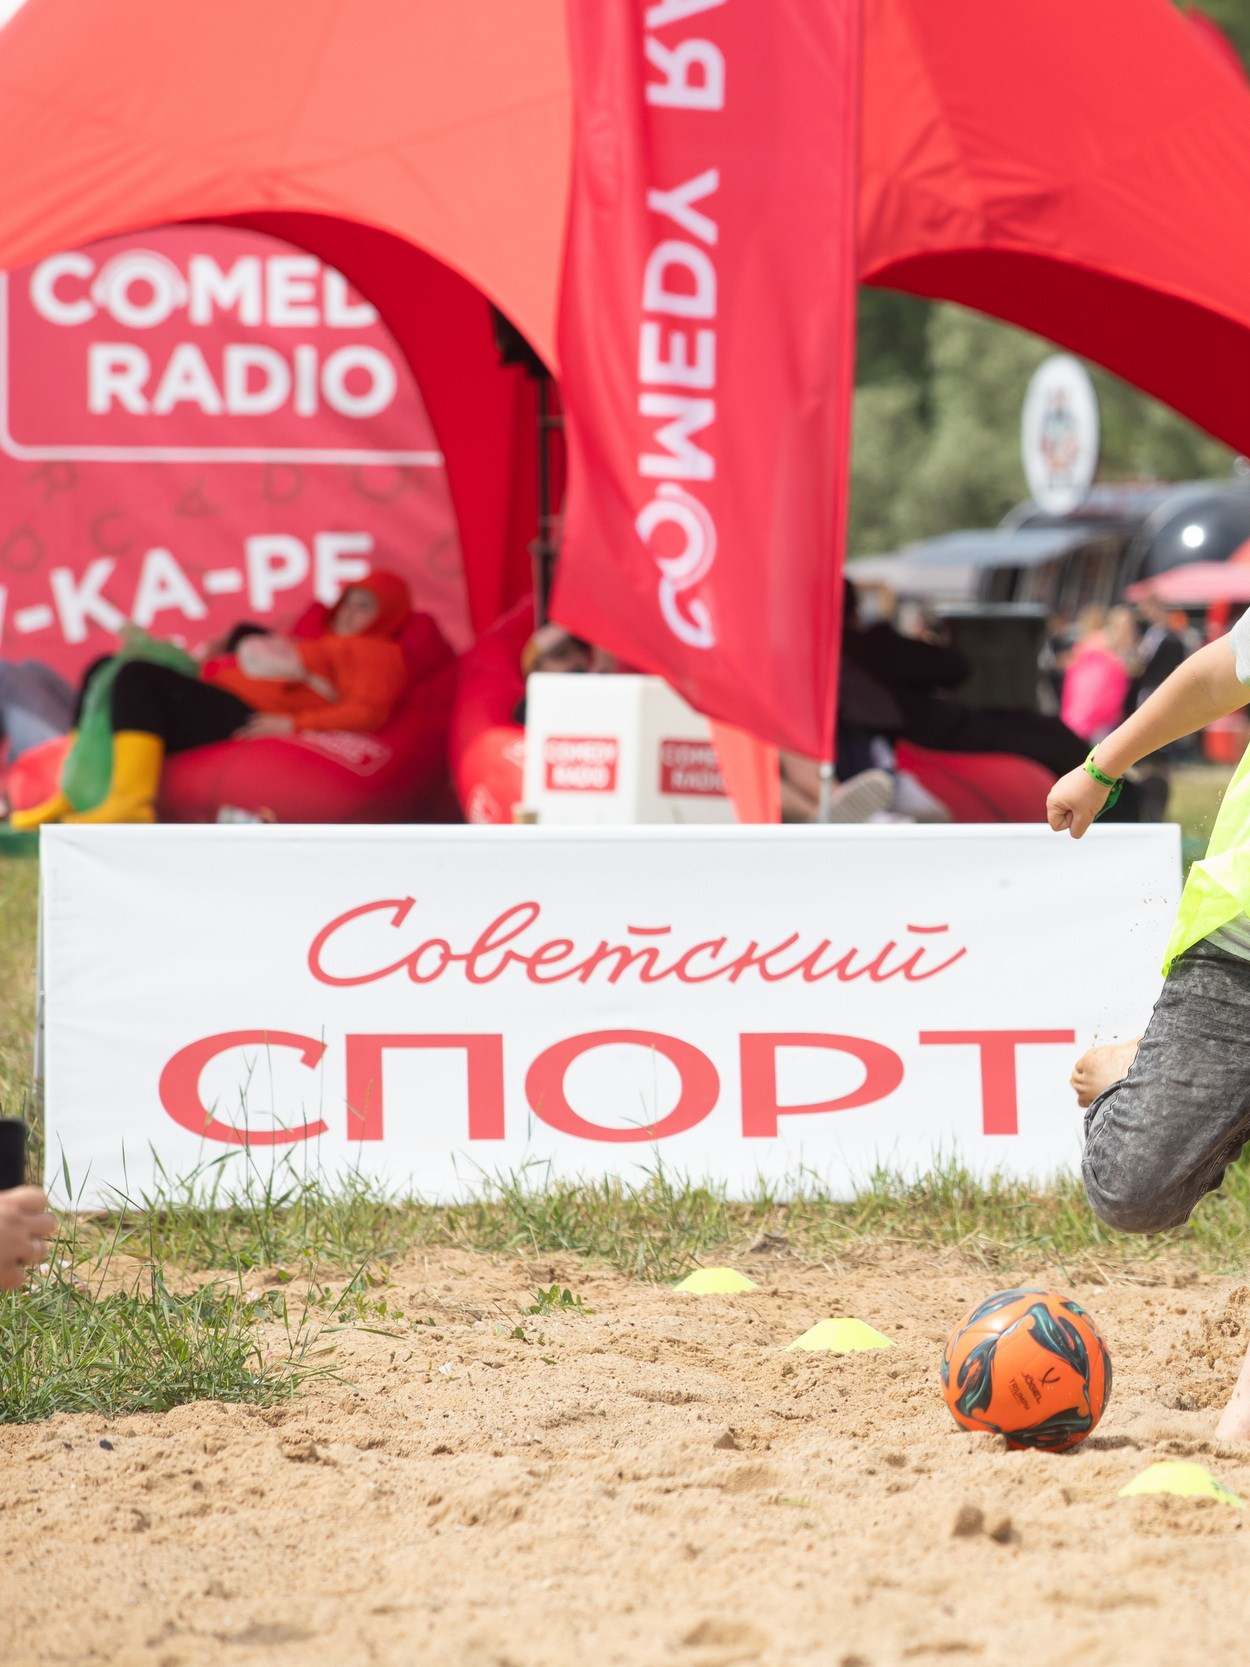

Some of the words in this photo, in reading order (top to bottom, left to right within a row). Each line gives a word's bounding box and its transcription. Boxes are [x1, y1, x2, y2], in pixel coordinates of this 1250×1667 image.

[87, 342, 398, 419] RADIO
[307, 895, 968, 988] Советский
[157, 1028, 1076, 1147] СПОРТ
[1008, 1377, 1031, 1411] TRIUMPH
